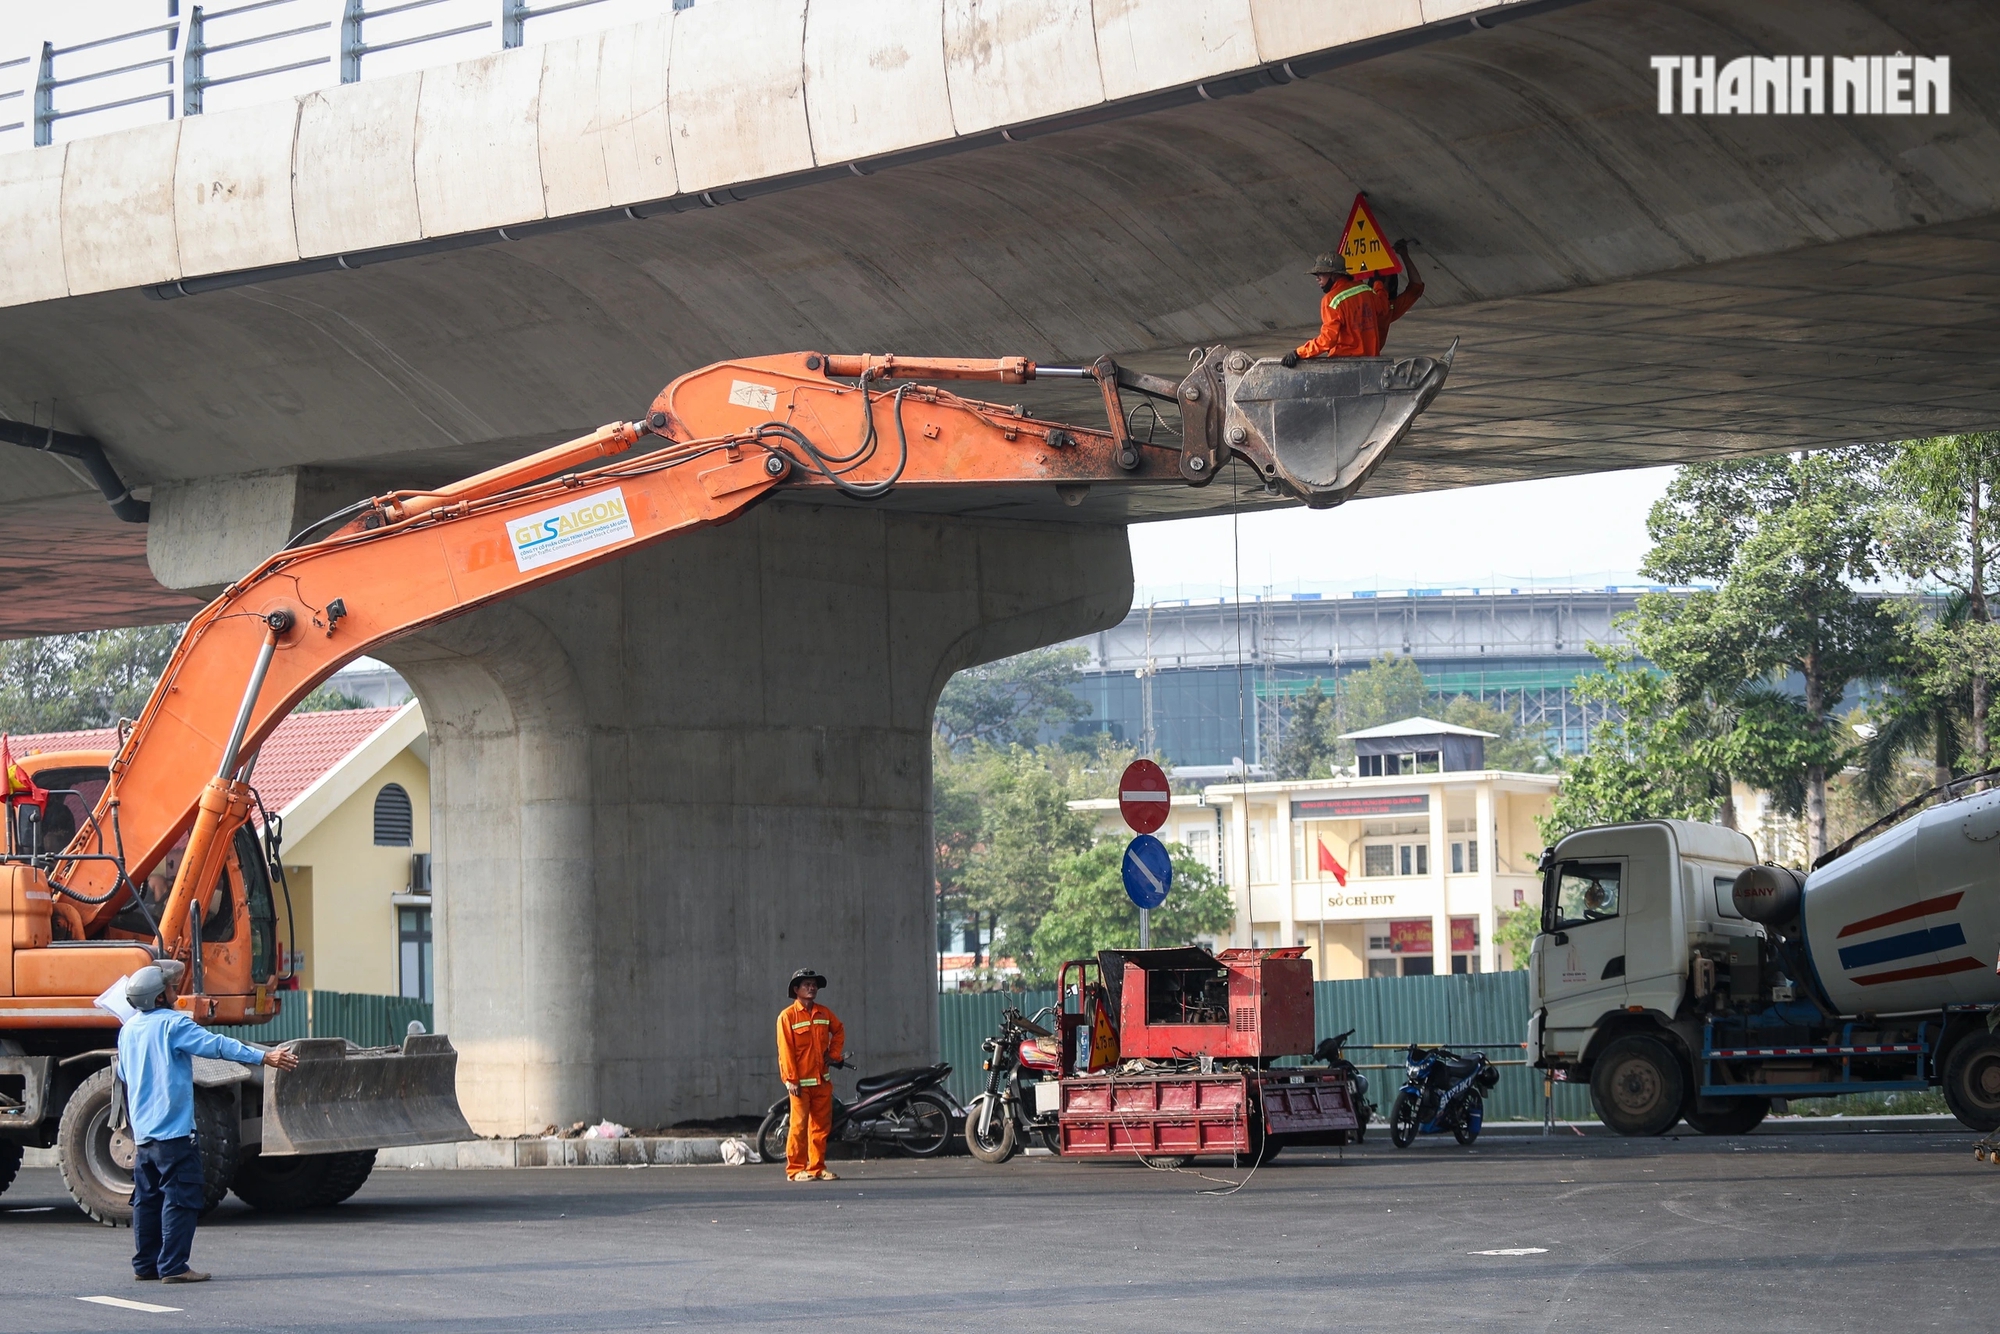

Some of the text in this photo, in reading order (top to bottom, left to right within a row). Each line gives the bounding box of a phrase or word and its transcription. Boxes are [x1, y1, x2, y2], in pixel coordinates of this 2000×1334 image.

[1344, 238, 1380, 257] 4.75 m
[521, 552, 537, 561] Saigon
[551, 538, 582, 551] Construction
[606, 525, 629, 535] Company
[1370, 895, 1395, 905] HUY
[1743, 888, 1774, 897] SANY
[1440, 1076, 1472, 1110] SUZUKI
